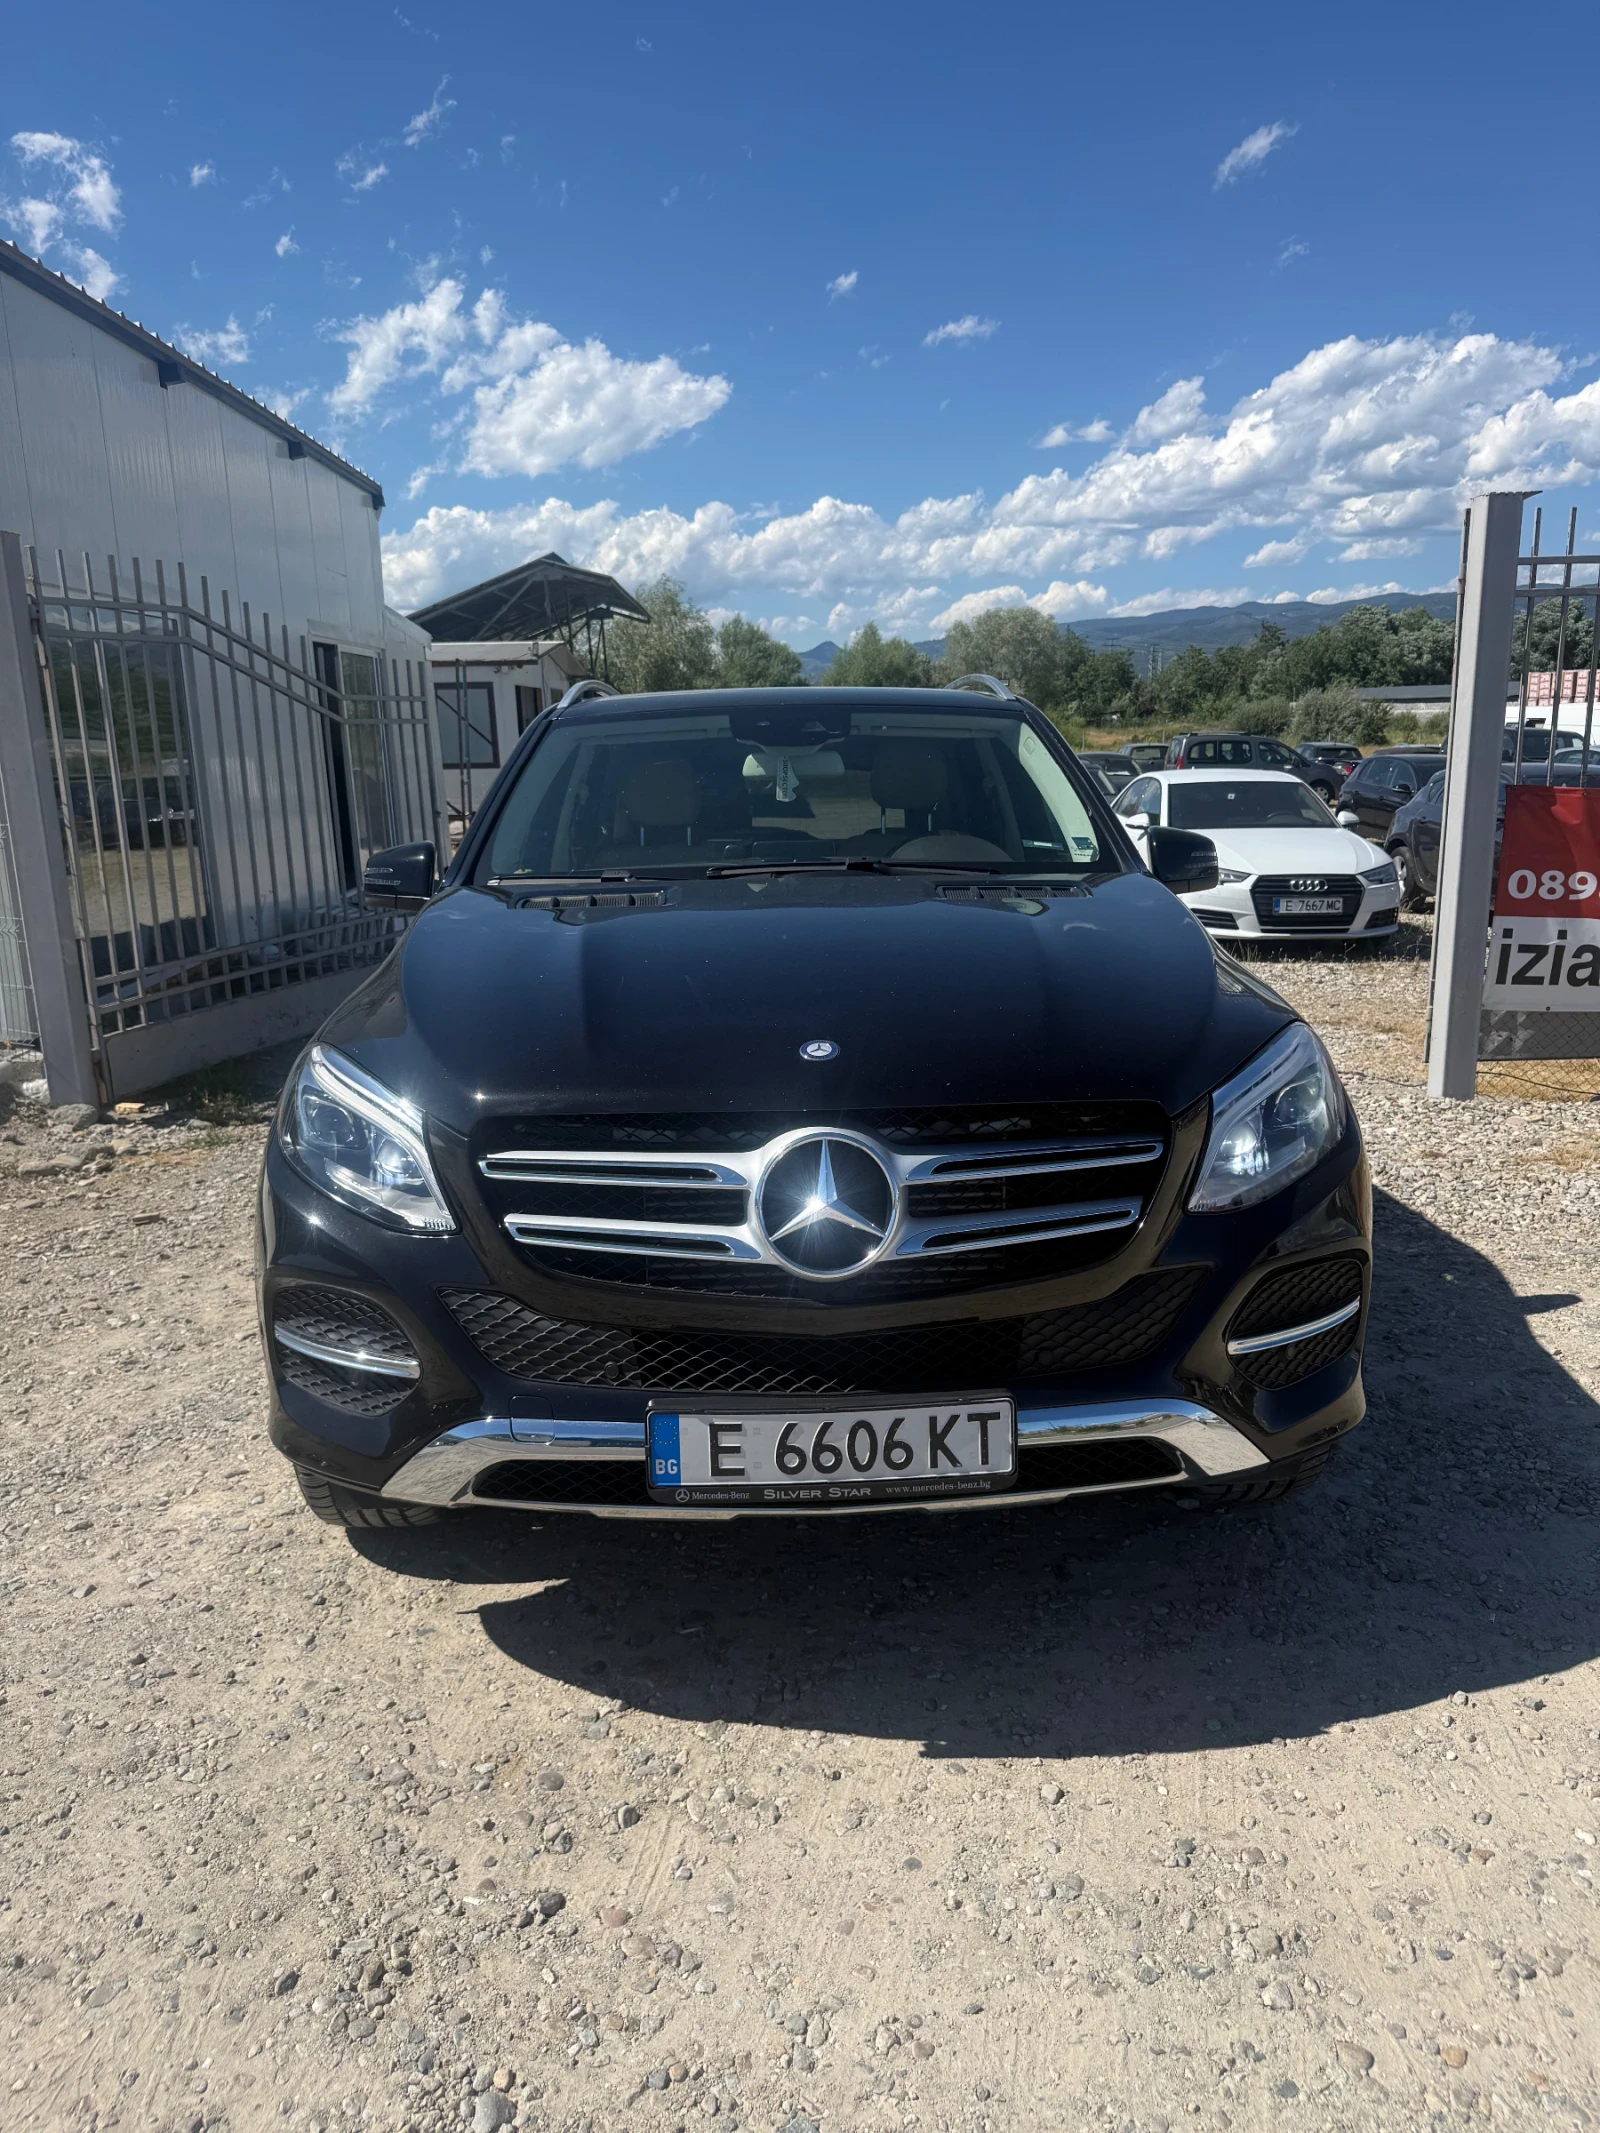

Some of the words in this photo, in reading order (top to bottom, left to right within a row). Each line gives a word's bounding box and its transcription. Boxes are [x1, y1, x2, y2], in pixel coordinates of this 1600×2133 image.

[1507, 869, 1600, 900] 089
[1285, 901, 1293, 911] E
[1298, 900, 1325, 911] 7667
[1326, 900, 1341, 911] MC
[709, 1422, 745, 1477] E
[774, 1417, 914, 1476] 6606
[929, 1411, 1001, 1470] KT
[655, 1458, 678, 1475] BG
[692, 1490, 750, 1500] Mercedes-Benz
[763, 1488, 822, 1500] SILVER
[828, 1487, 872, 1498] STAR
[885, 1479, 991, 1494] www.mercedes-benz.bg
